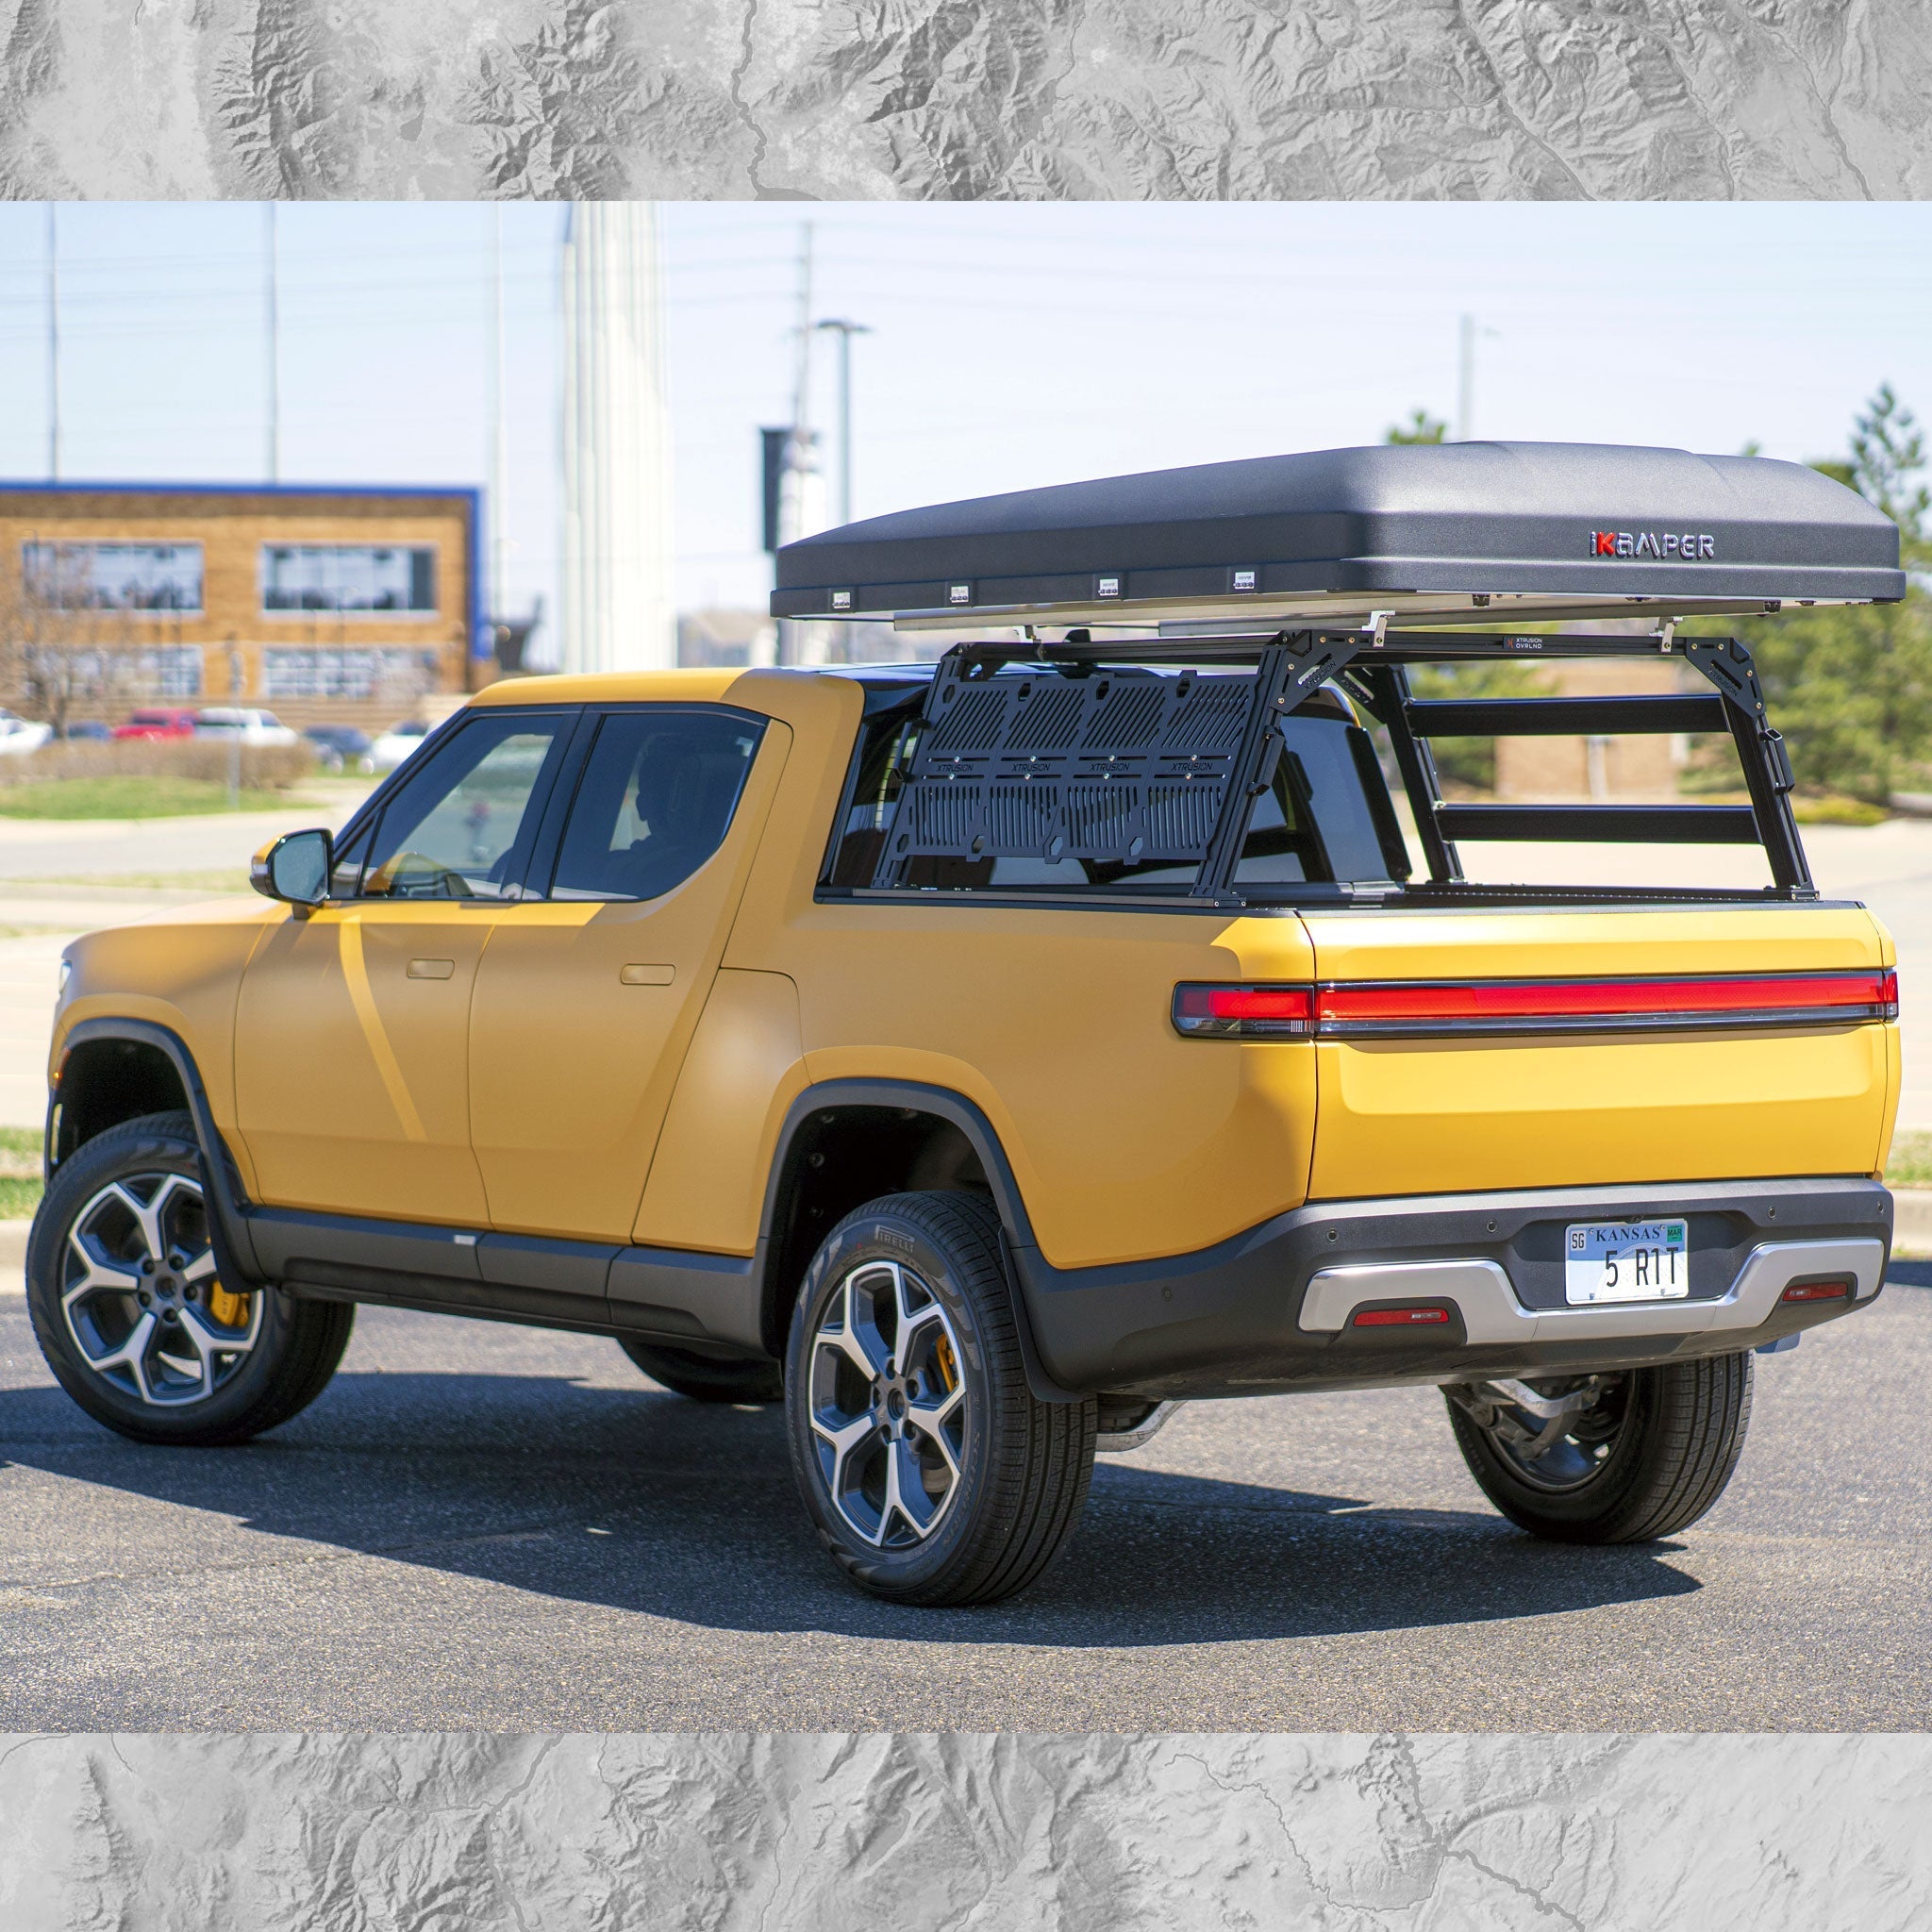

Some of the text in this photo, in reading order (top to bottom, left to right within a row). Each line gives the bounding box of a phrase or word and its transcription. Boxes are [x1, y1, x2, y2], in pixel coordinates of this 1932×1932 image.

[937, 763, 974, 773] XTRUSION
[1012, 763, 1050, 772] XTRUSION
[1090, 762, 1130, 772] XTRUSION
[1171, 762, 1213, 772] XTRUSION
[1596, 1226, 1661, 1242] KANSAS
[1667, 1228, 1683, 1237] MAR
[1572, 1232, 1585, 1249] SG
[1606, 1246, 1679, 1288] 5 R1T
